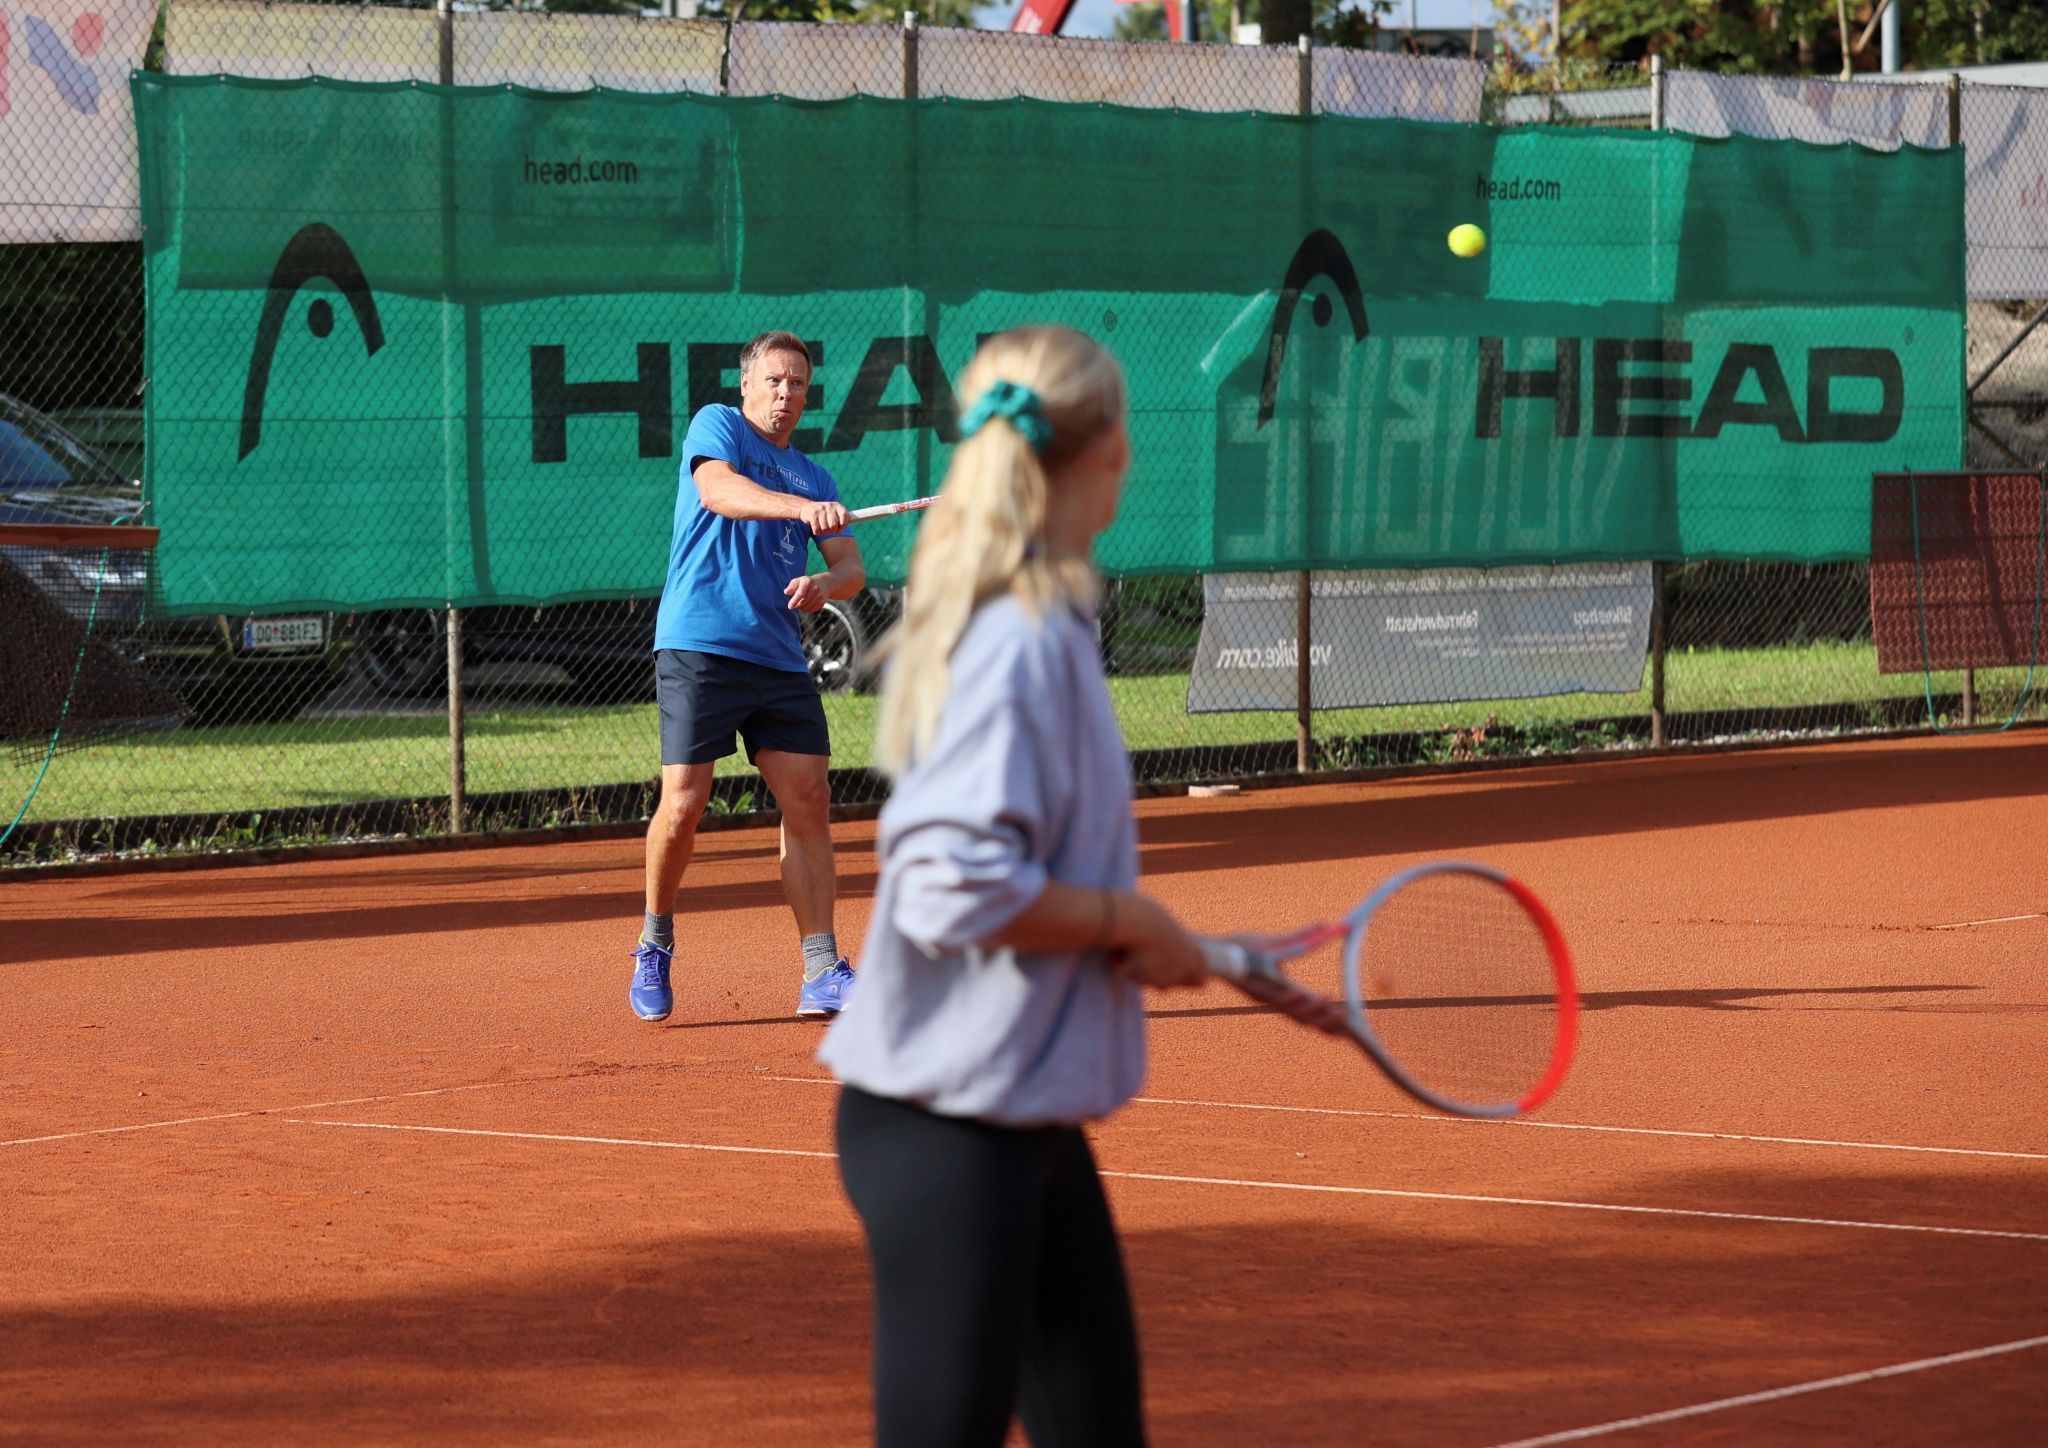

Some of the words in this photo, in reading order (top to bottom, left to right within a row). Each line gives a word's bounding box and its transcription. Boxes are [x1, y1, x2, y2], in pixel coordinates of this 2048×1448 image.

[524, 154, 638, 185] head.com
[1475, 173, 1561, 202] head.com
[530, 331, 1000, 464] HEA
[1475, 336, 1905, 444] HEAD
